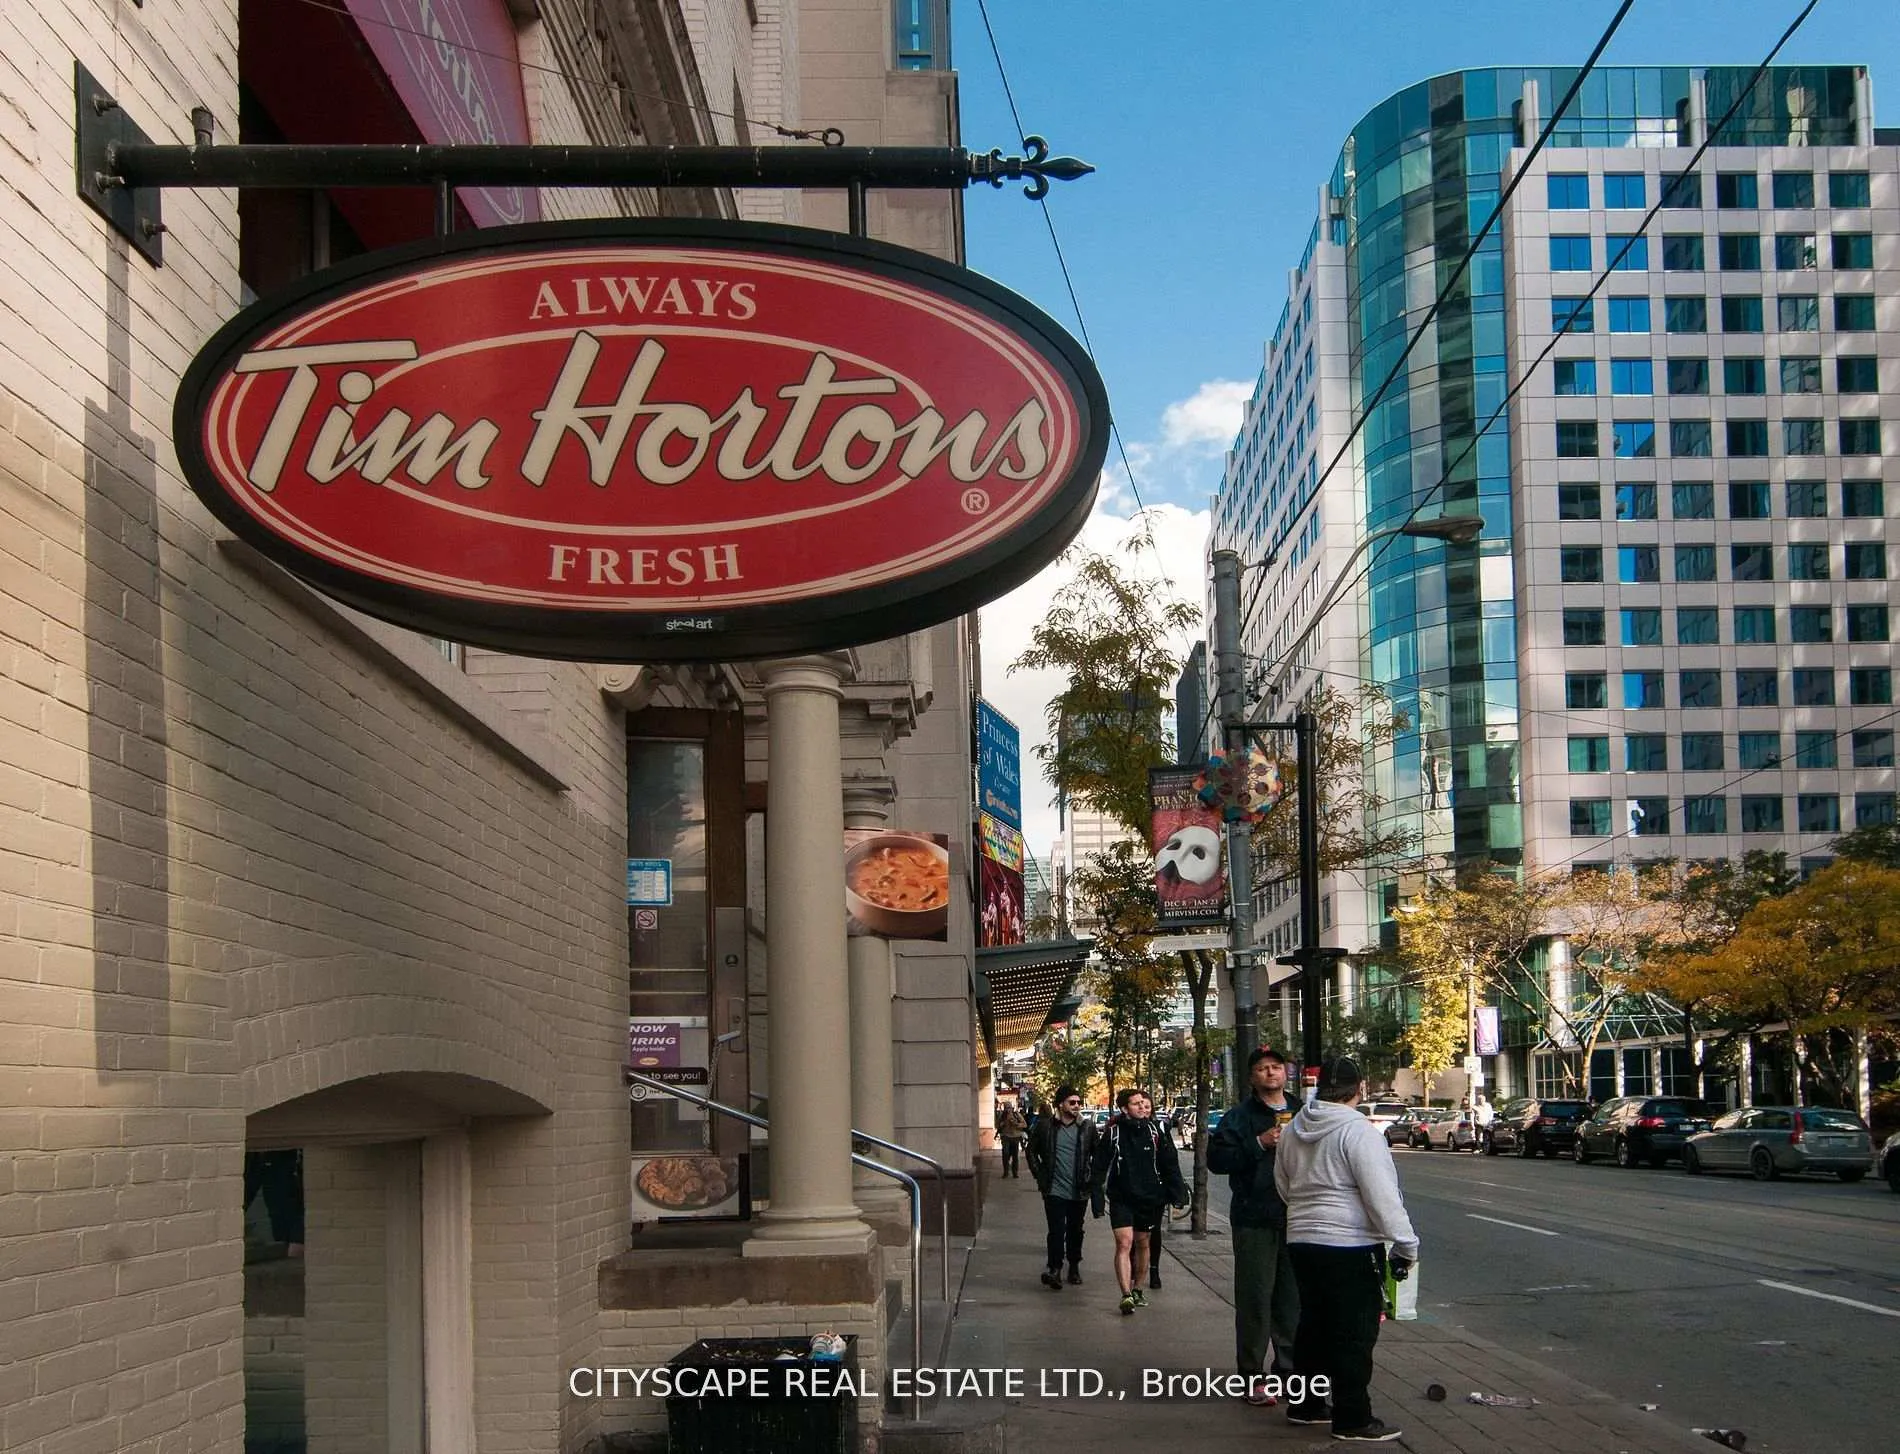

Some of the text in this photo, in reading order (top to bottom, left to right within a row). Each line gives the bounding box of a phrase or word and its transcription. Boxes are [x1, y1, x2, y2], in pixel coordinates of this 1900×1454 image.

[529, 276, 757, 320] ALWAYS
[234, 329, 1047, 493] Tim Hortons
[548, 544, 743, 586] FRESH
[696, 619, 713, 630] art
[983, 711, 1018, 757] Princess
[996, 751, 1018, 786] Wales
[1153, 793, 1199, 805] PHANT
[1164, 909, 1219, 918] MIRVISH.COM
[629, 1025, 667, 1033] NOW
[629, 1037, 677, 1045] IRING
[681, 1072, 701, 1081] you!
